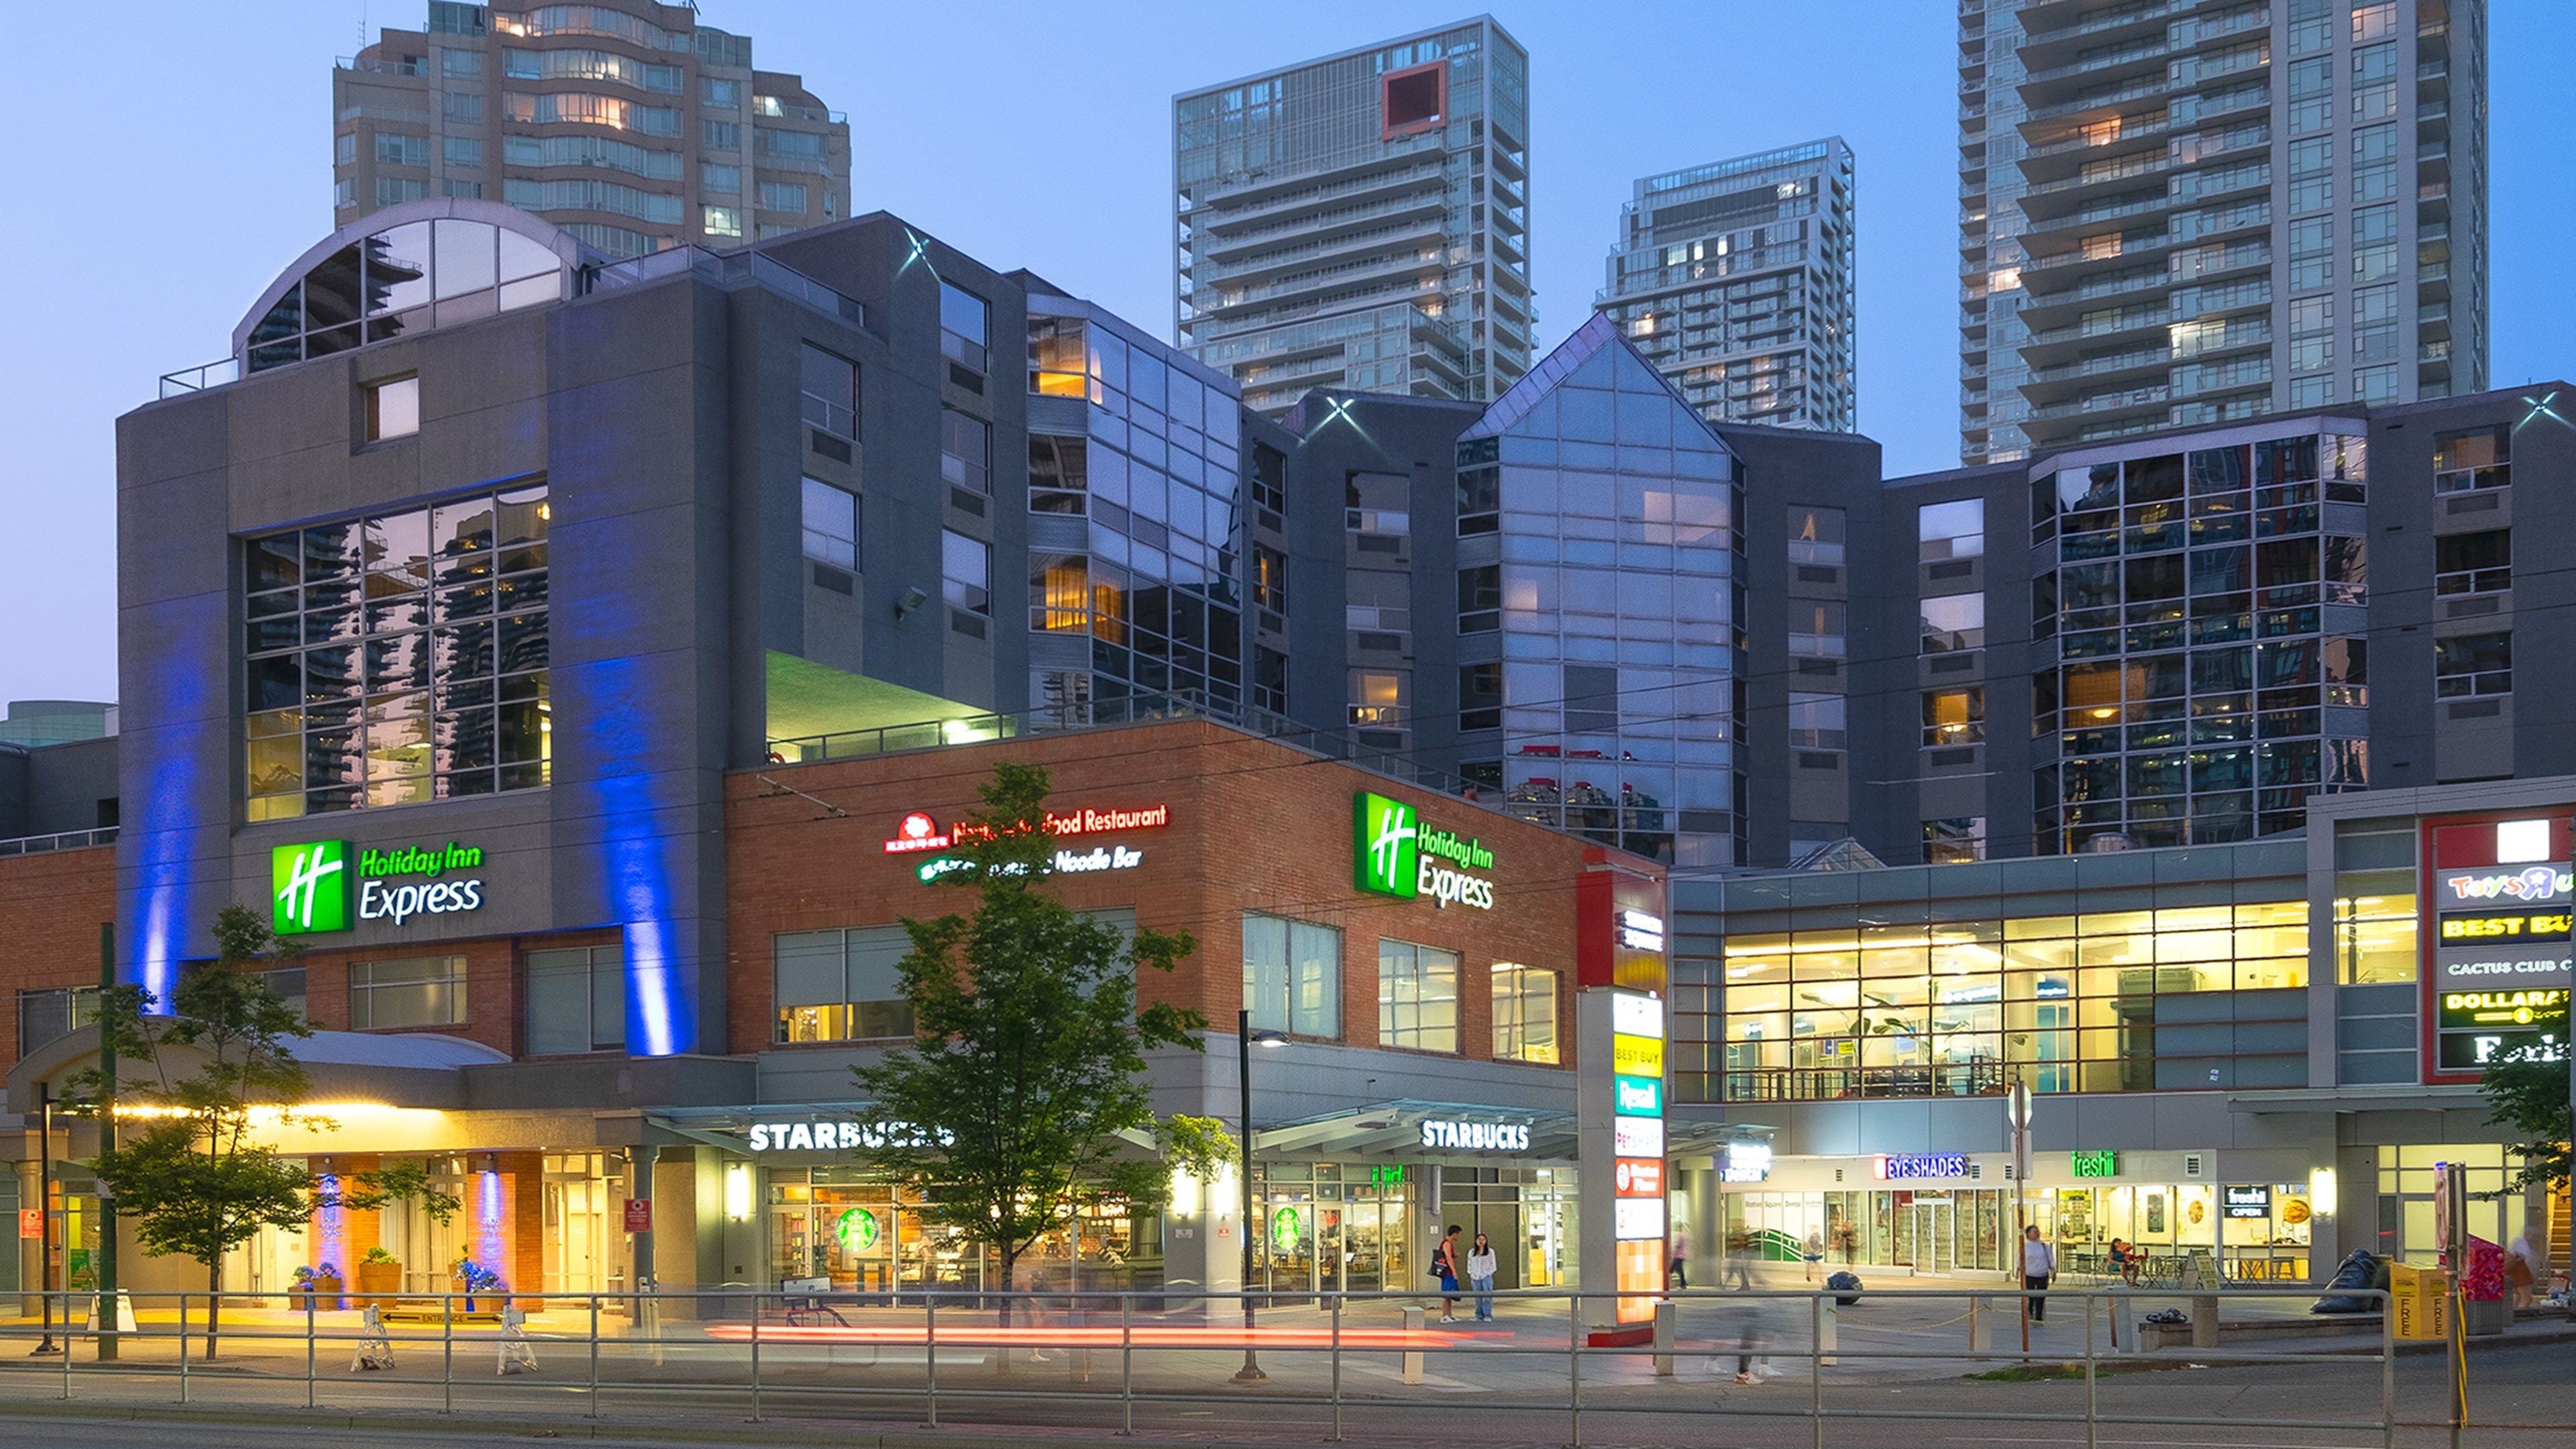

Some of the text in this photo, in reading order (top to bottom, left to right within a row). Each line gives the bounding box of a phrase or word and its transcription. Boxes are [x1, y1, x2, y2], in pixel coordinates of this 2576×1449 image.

[1085, 804, 1167, 831] Restaurant
[1055, 847, 1111, 871] Noodle
[1112, 845, 1142, 868] Bar
[1417, 822, 1493, 869] Holiday Inn
[360, 842, 482, 877] Holiday Inn
[1417, 855, 1493, 910] Express
[360, 879, 482, 925] Express
[2443, 914, 2573, 938] BEST BU
[2448, 961, 2512, 975] CACTUS
[2515, 959, 2557, 973] CLUB
[1615, 1048, 1659, 1065] BEST BUY
[1422, 1120, 1529, 1150] STARBUCKS
[1888, 1156, 1964, 1178] EYE SHADES
[2071, 1150, 2116, 1177] freshii
[422, 1314, 464, 1323] ENTRNCE
[2401, 1298, 2410, 1336] FREE
[2434, 1298, 2443, 1336] FREE
